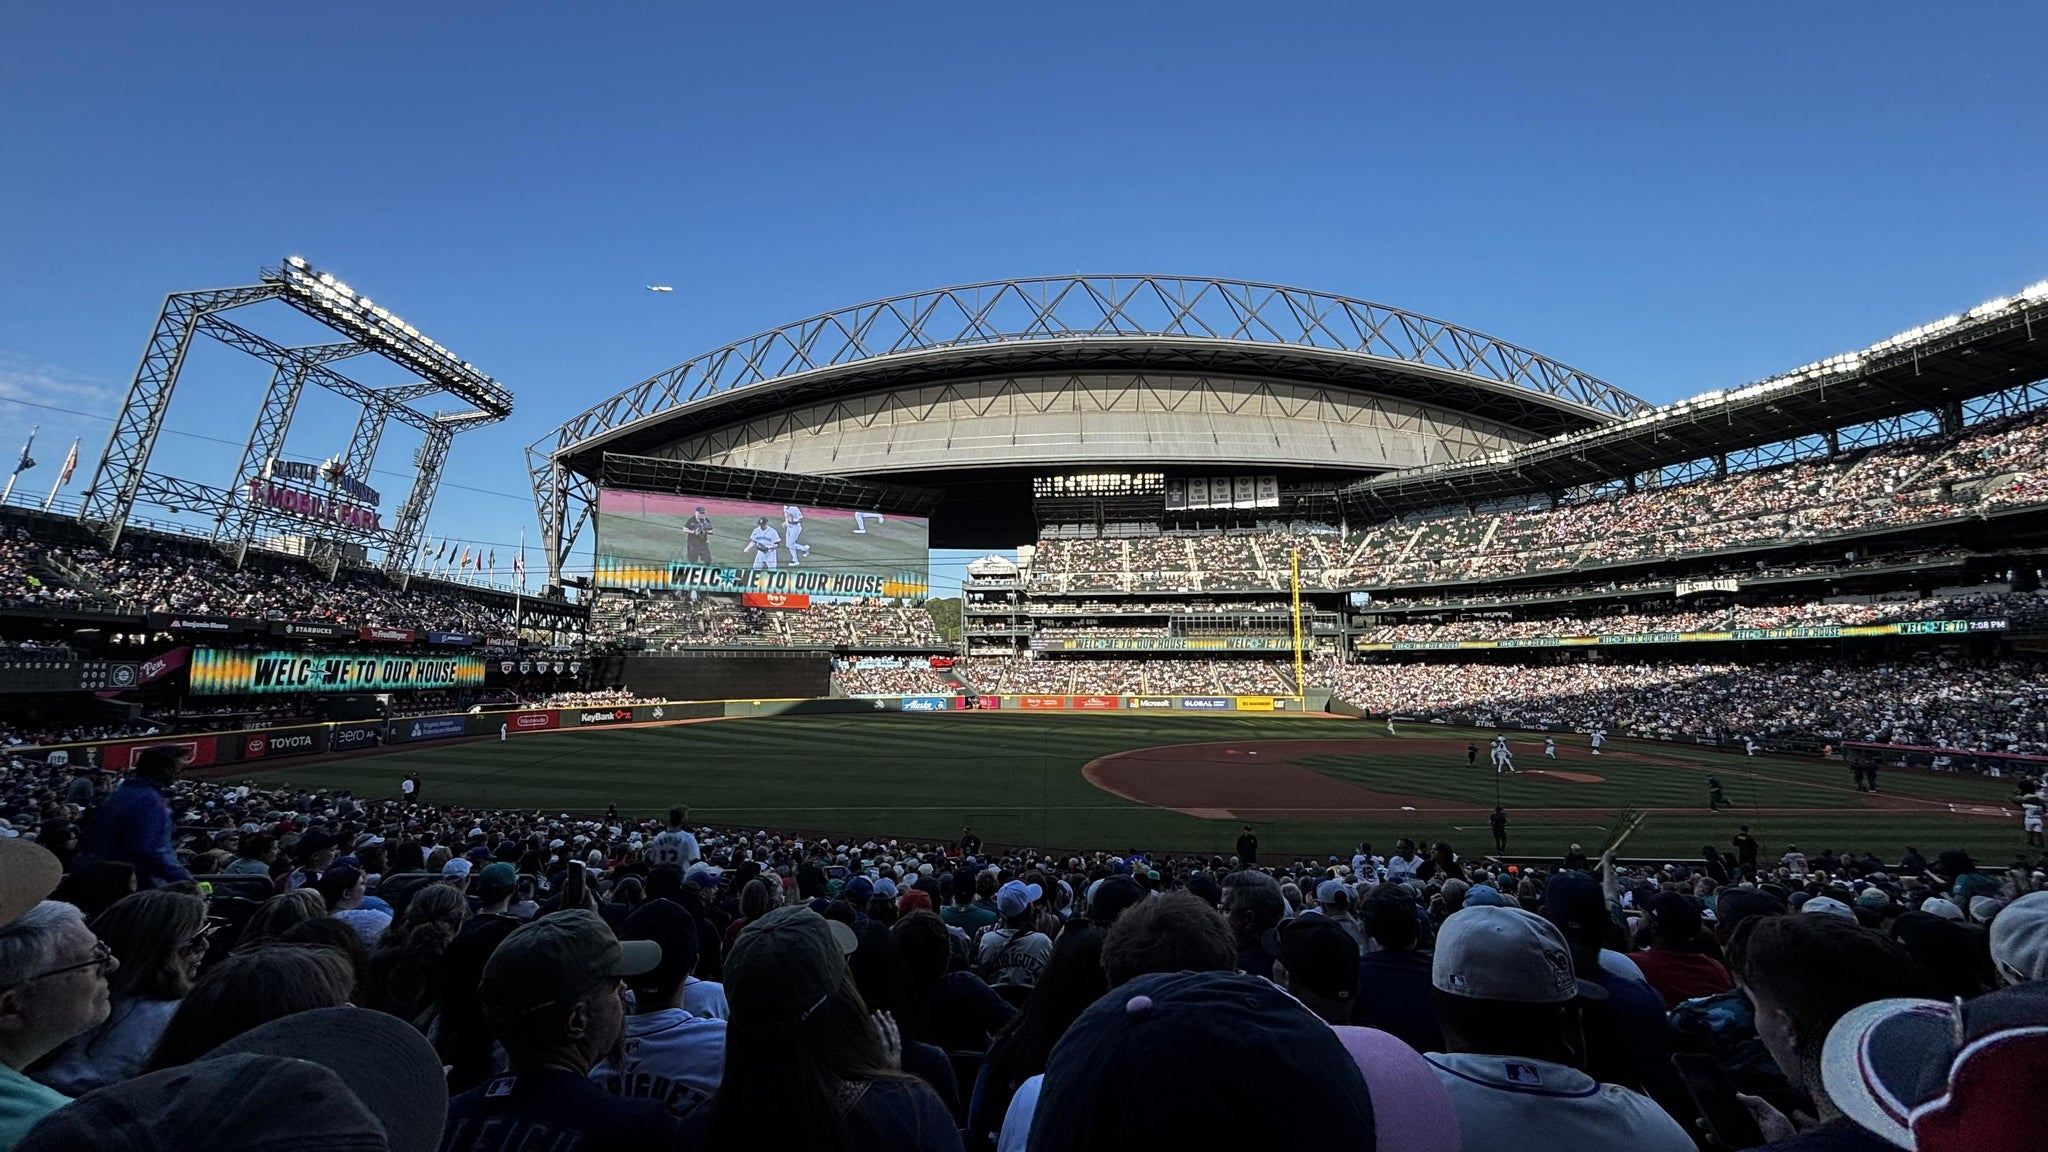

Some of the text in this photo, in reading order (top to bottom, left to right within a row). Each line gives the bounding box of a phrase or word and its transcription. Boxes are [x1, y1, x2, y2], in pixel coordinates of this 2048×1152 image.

[250, 479, 382, 533] T-MOBILE PARK
[767, 571, 787, 589] TO
[796, 572, 828, 591] OUR
[833, 573, 884, 594] HOUSE
[1676, 578, 1738, 595] ALL-STAR CLUB
[295, 626, 333, 635] STARBUCKS
[1952, 620, 1965, 631] TO
[1991, 620, 2006, 629] PM
[1631, 634, 1639, 643] TO
[1642, 633, 1656, 643] OUR
[1658, 633, 1680, 642] HOUSE
[1777, 630, 1786, 638] TO
[1791, 628, 1809, 637] OUR
[1813, 627, 1840, 637] HOUSE
[1123, 638, 1133, 650] TO
[1137, 638, 1154, 650] OUR
[1158, 638, 1187, 650] HOUSE
[1275, 638, 1286, 650] TO
[356, 659, 379, 685] TO
[381, 660, 413, 684] OUR
[415, 659, 457, 683] HOUSE
[903, 699, 934, 710] Alaska
[1274, 700, 1285, 708] CAT
[581, 711, 615, 723] KeyBank
[1475, 720, 1497, 728] STIHL
[270, 736, 313, 750] TOYOTA
[1362, 866, 1375, 879] 12
